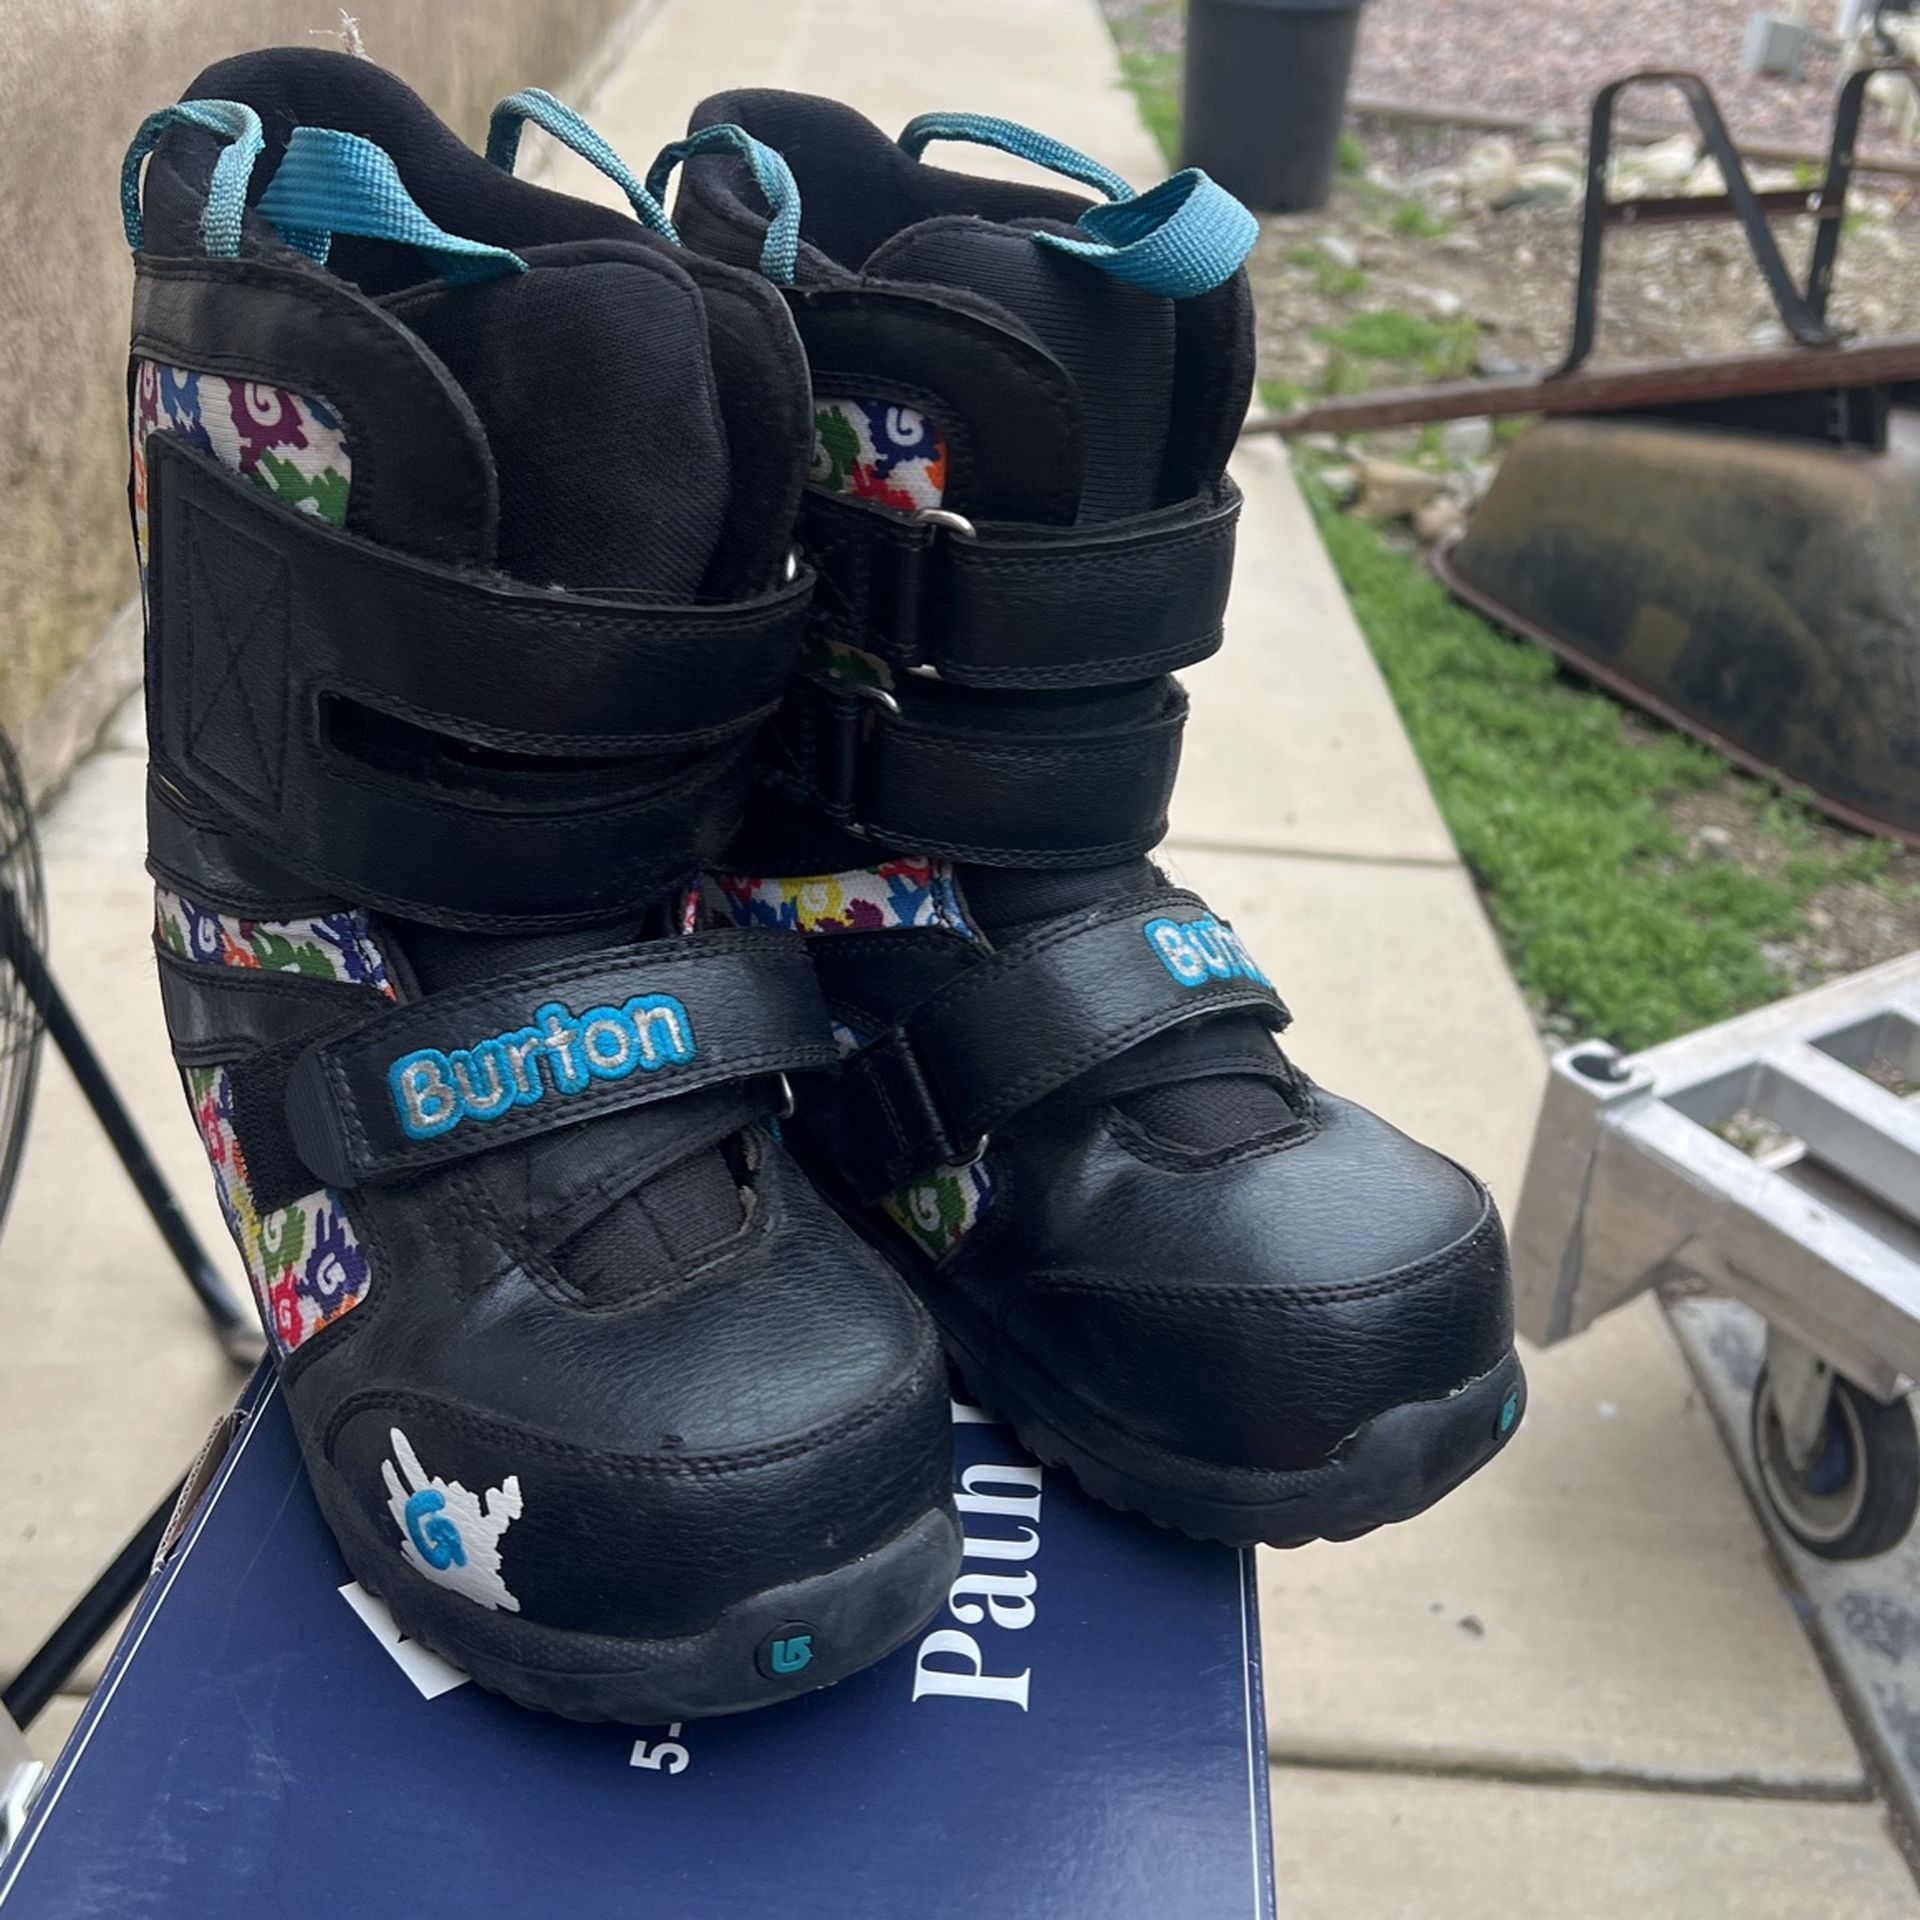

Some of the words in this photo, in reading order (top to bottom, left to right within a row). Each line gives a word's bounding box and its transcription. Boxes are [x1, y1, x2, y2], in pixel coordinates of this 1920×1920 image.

[1143, 912, 1273, 988] Bur
[388, 992, 697, 1140] Burton
[912, 1463, 1043, 1712] Path
